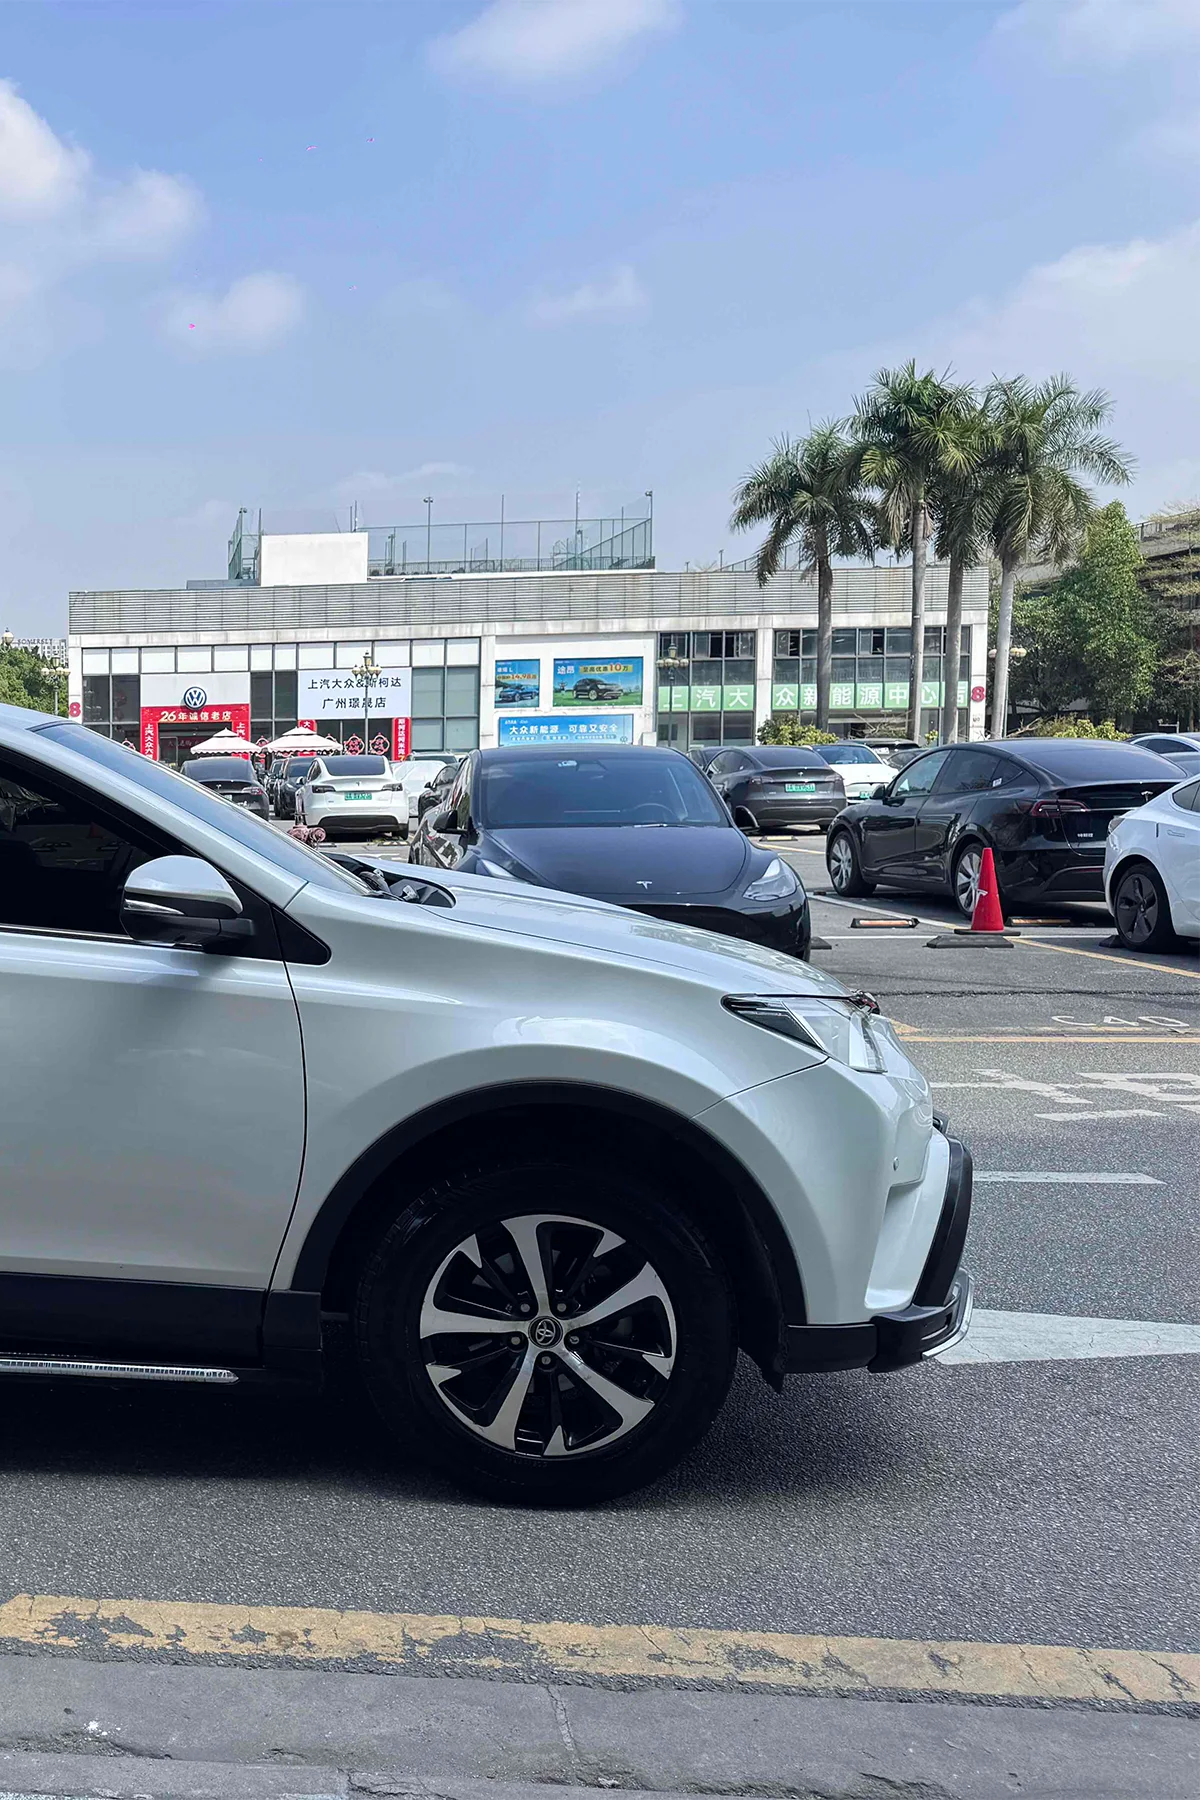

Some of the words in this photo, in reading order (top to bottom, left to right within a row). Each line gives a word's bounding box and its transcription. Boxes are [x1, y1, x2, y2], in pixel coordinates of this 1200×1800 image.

[971, 686, 985, 702] 8
[69, 702, 81, 717] 8
[160, 711, 232, 722] 26年诚信老店
[509, 725, 559, 735] 大众新能源
[569, 723, 618, 733] 可靠又安全
